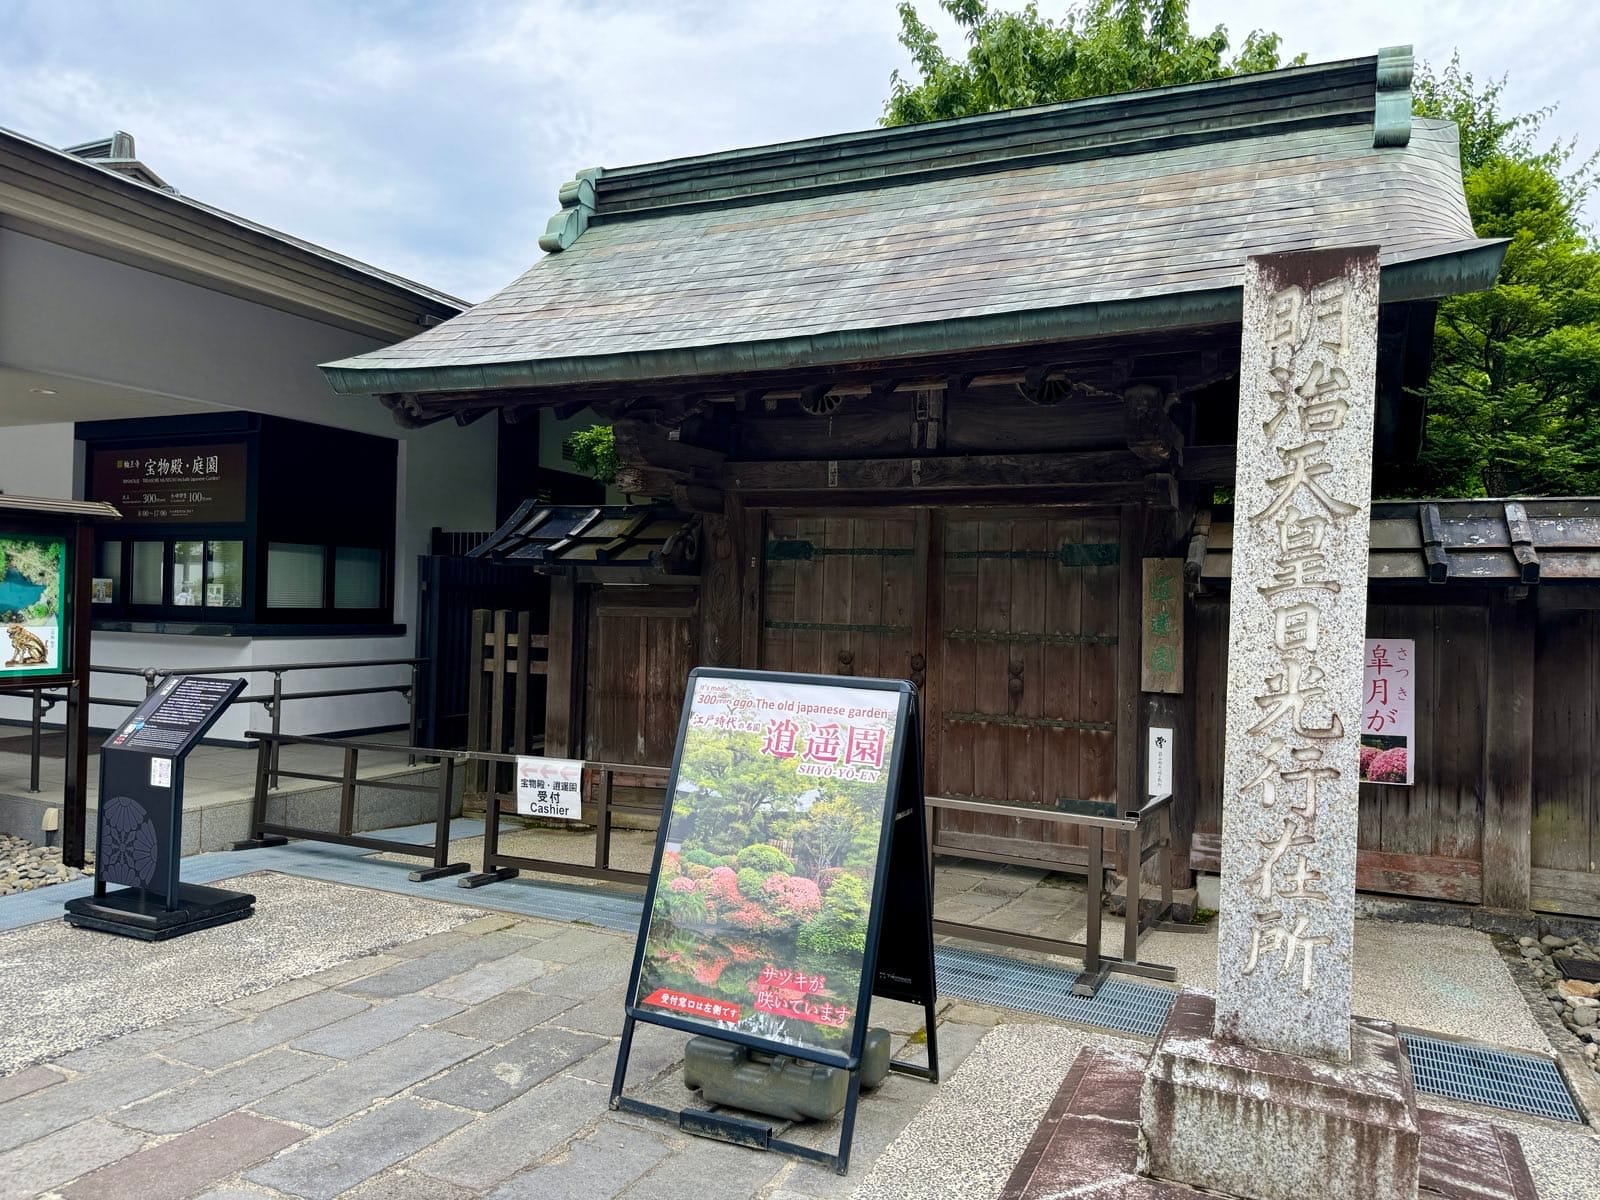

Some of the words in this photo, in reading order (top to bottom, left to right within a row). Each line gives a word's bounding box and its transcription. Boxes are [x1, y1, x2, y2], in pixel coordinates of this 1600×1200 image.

[144, 455, 219, 476] 宝物殿・庭園
[142, 493, 157, 504] 300
[189, 492, 202, 502] 100
[1239, 275, 1361, 994] 明治天皇日光行在所
[1395, 647, 1410, 702] さつき
[1366, 643, 1399, 733] 皐月が
[756, 698, 775, 710] The
[777, 700, 795, 712] old
[796, 703, 846, 716] japanese
[847, 706, 888, 720] garden
[761, 718, 887, 768] 逍遥園
[530, 802, 570, 816] Cashier
[537, 790, 561, 804] 受付
[762, 967, 826, 992] サツキが
[660, 993, 738, 1018] 受付窓口は左側です
[758, 991, 851, 1025] 咲いています
